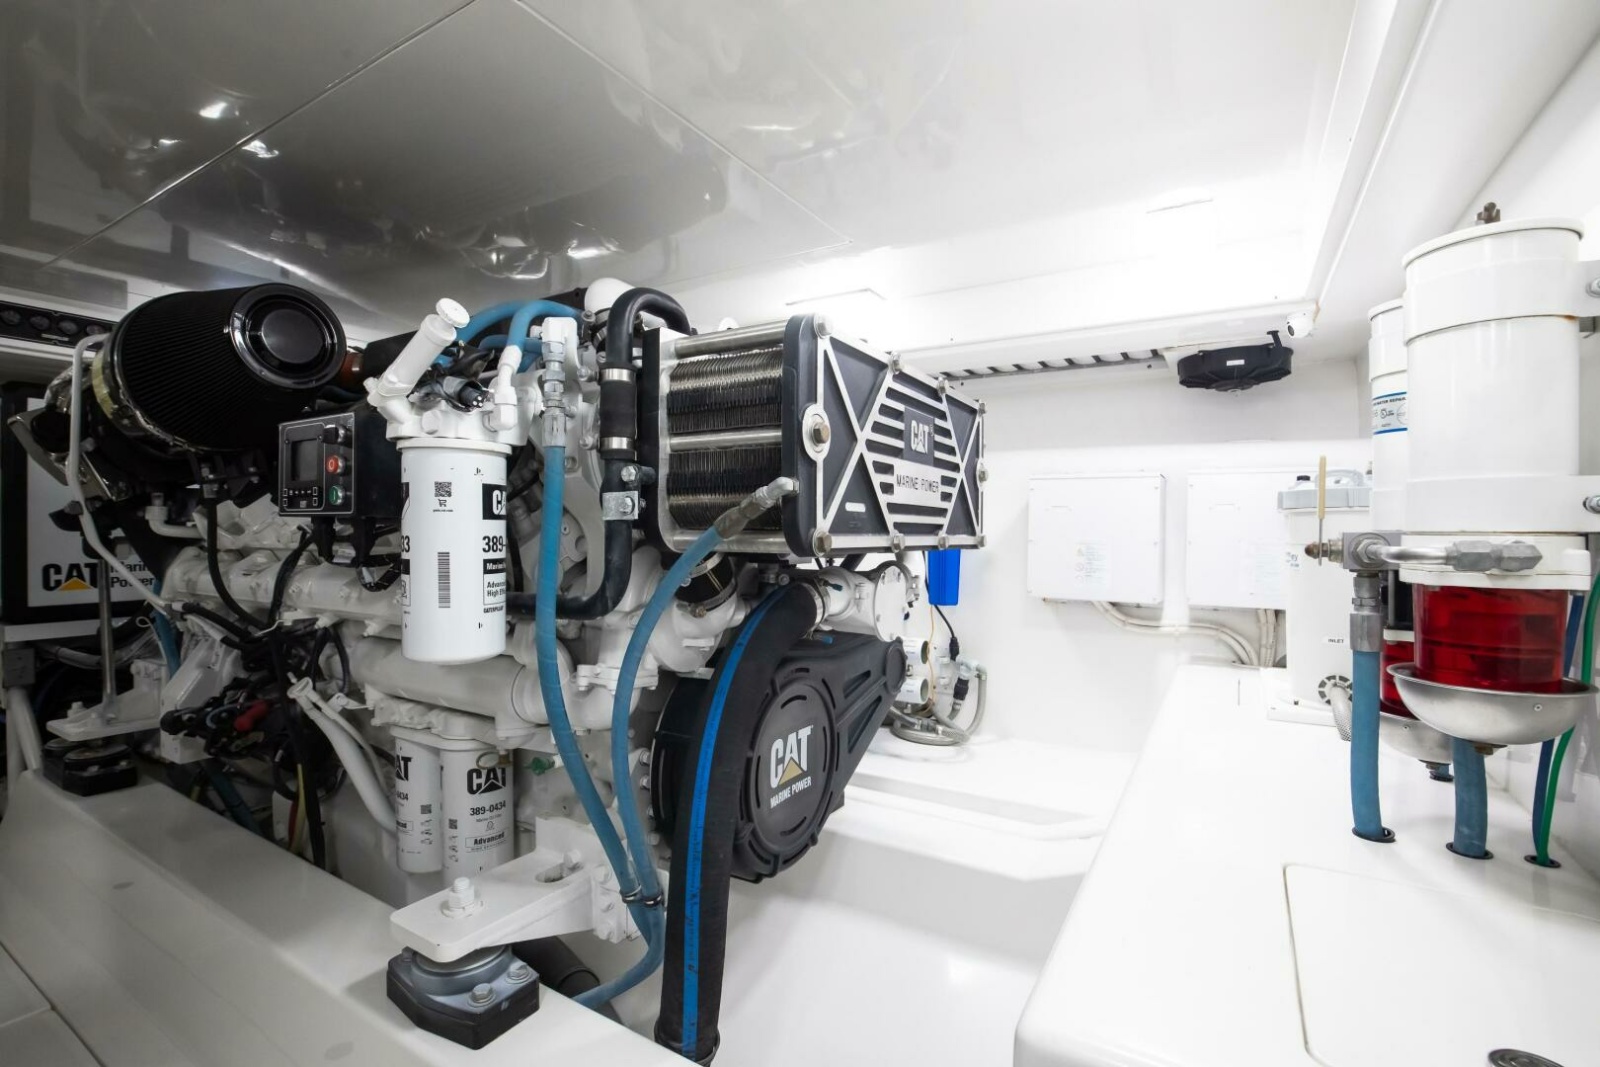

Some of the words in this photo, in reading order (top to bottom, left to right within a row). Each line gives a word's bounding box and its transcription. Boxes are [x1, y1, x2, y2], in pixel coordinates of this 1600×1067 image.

[911, 419, 929, 454] CAT
[896, 474, 919, 490] MARINE
[921, 478, 939, 493] POWER
[492, 490, 507, 515] CA
[42, 562, 99, 592] CAT
[110, 577, 155, 588] Poer
[396, 754, 413, 781] AT
[770, 726, 812, 789] CAT
[467, 767, 506, 795] CAT
[770, 786, 791, 809] MARINE
[791, 776, 812, 796] POWER
[469, 800, 507, 816] 389-0434
[473, 831, 505, 846] Advanced
